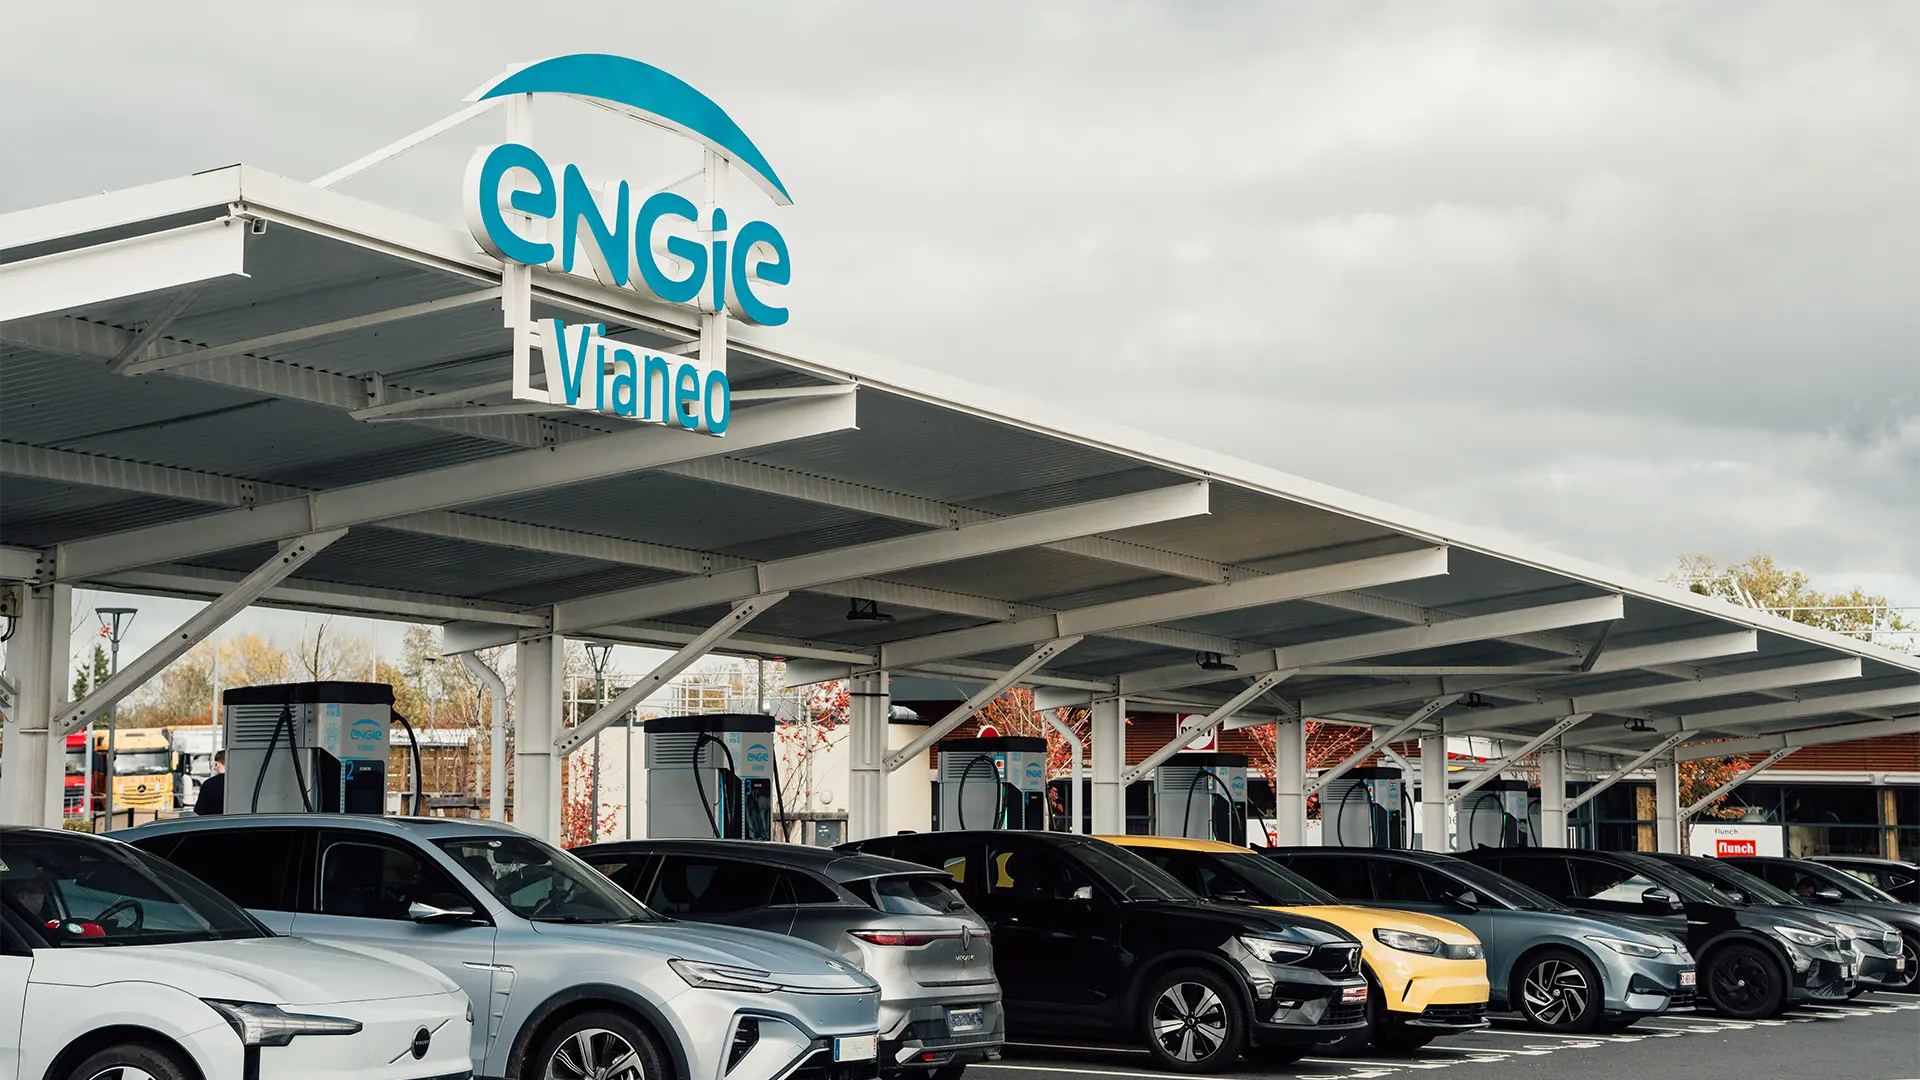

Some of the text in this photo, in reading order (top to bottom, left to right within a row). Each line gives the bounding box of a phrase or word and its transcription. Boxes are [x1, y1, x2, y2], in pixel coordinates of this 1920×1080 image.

[553, 318, 731, 434] Vianeo
[346, 760, 354, 780] 2
[745, 778, 752, 795] 3
[1719, 842, 1754, 854] flunch
